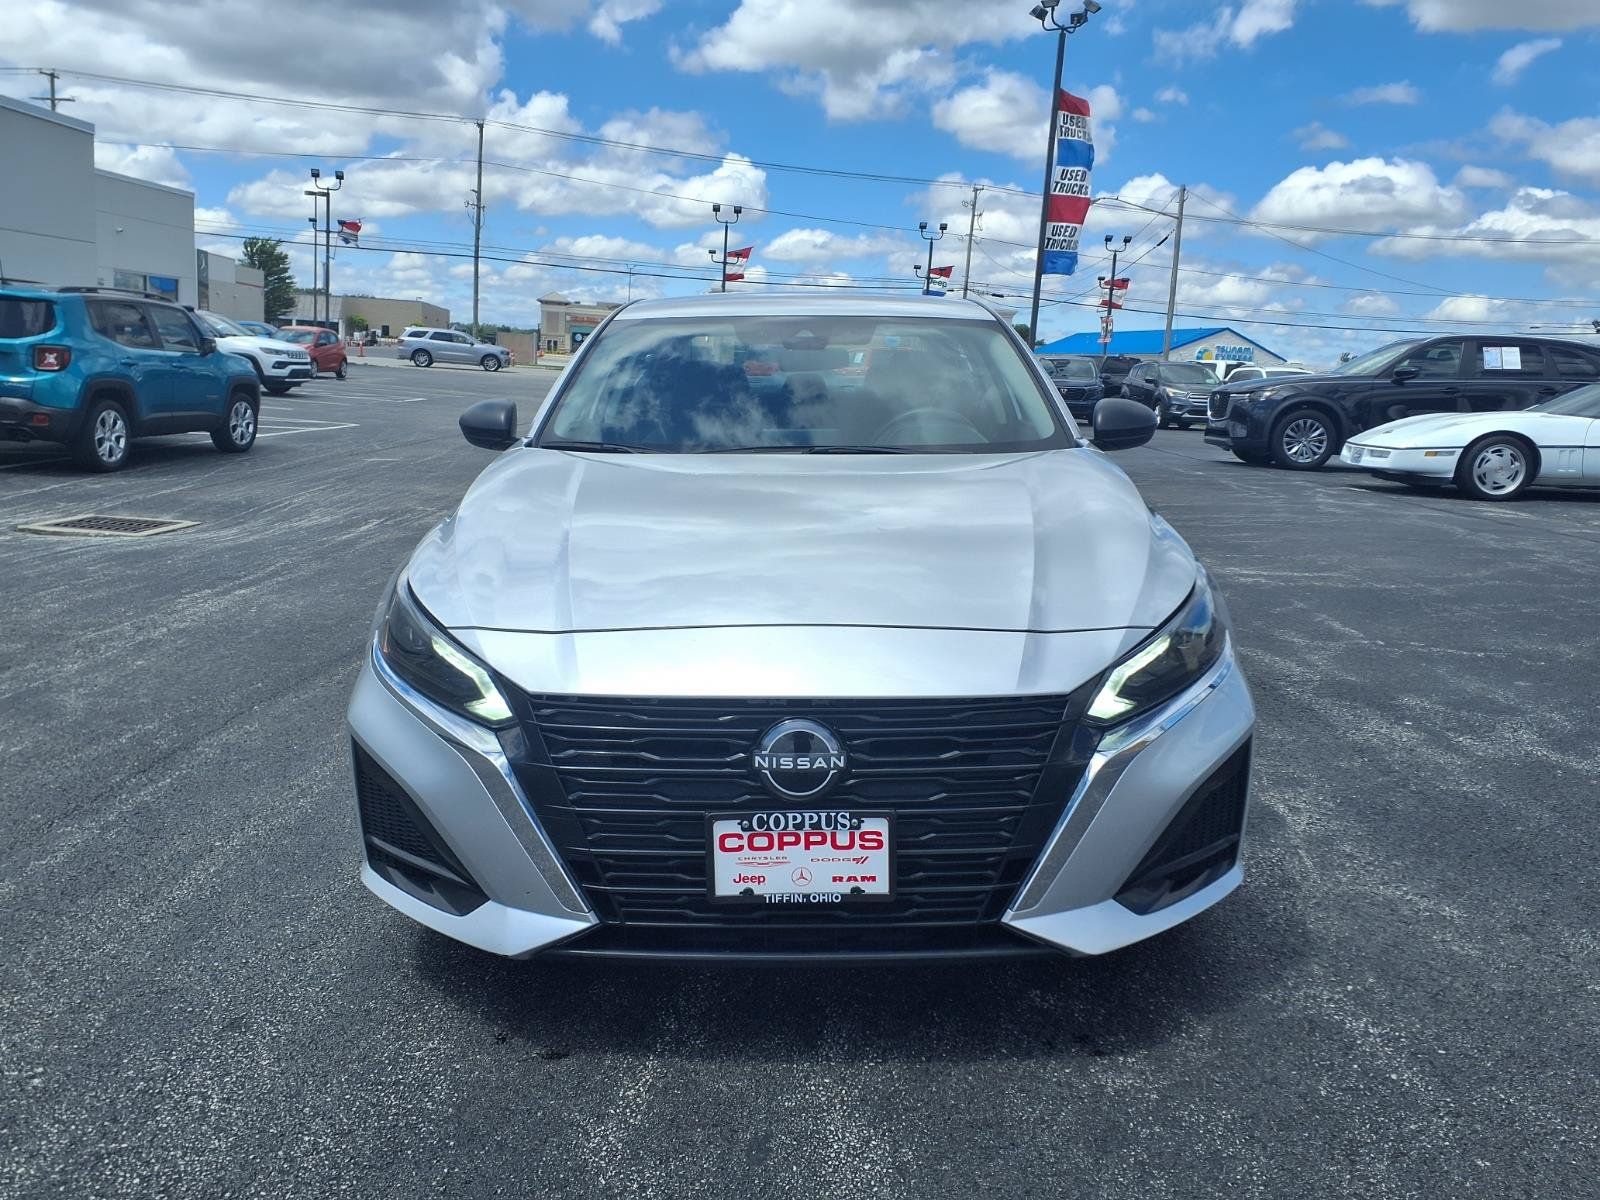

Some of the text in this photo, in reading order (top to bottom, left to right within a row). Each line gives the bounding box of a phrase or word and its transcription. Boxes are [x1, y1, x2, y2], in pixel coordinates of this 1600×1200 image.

[1062, 113, 1088, 129] USED
[1059, 124, 1092, 142] TRUCKS
[1060, 168, 1087, 182] USED
[1052, 181, 1089, 196] TRUCKS
[1051, 224, 1077, 238] USED
[1044, 237, 1079, 251] TRUCKS
[754, 755, 845, 769] NISSAN
[752, 812, 851, 831] COPPUS
[718, 830, 884, 852] COPPUS
[733, 873, 766, 885] Jeep
[831, 875, 877, 883] RAM
[809, 893, 842, 903] OHIO
